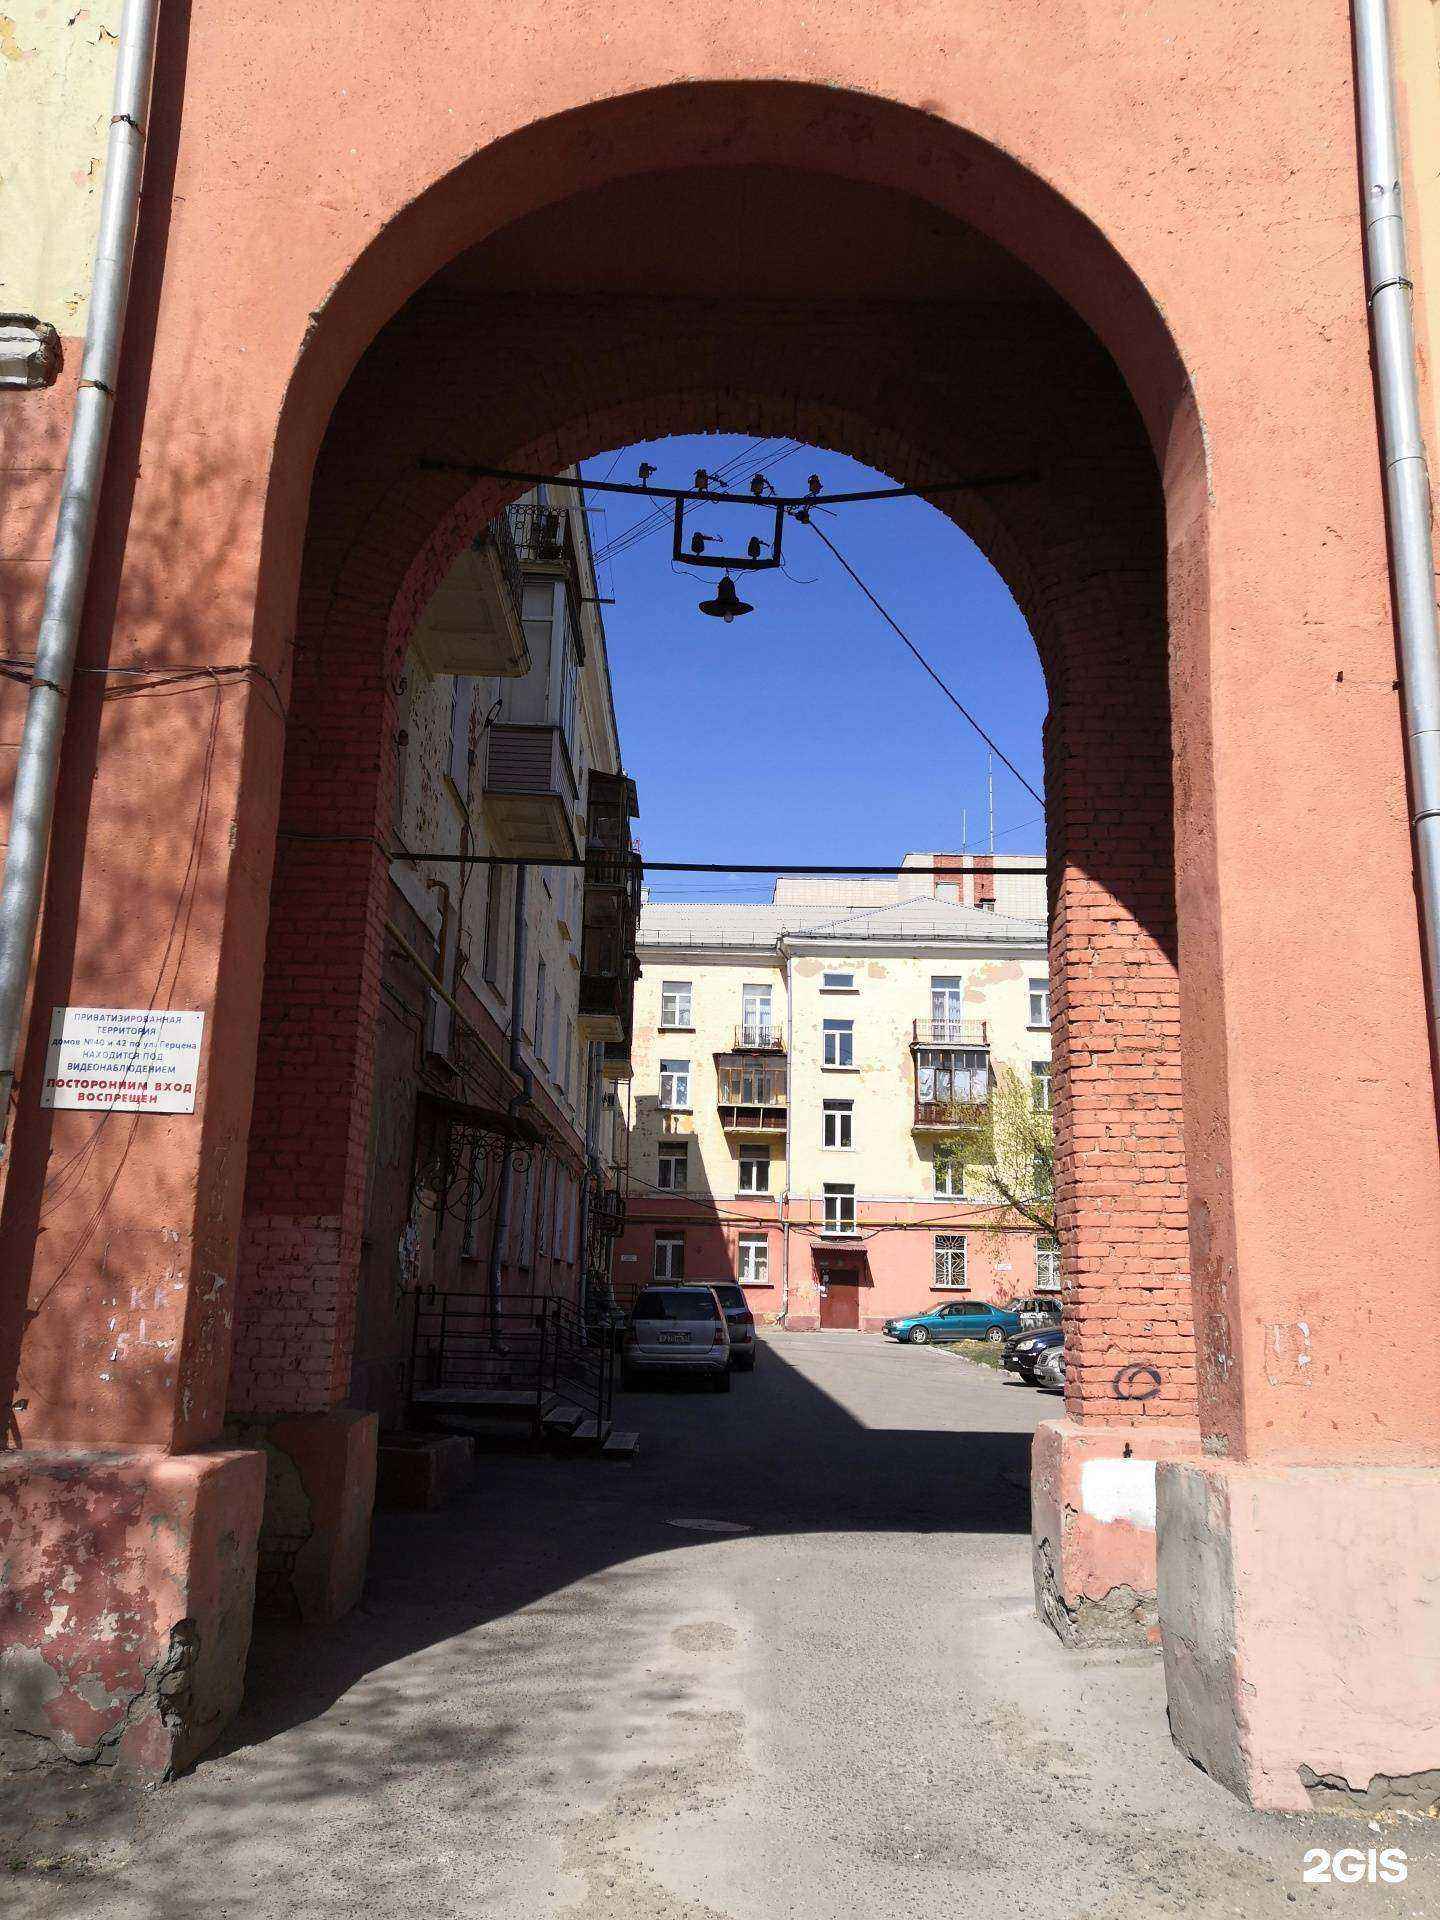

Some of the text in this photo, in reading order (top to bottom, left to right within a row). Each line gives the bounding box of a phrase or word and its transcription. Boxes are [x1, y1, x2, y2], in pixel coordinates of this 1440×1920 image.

[74, 1013, 182, 1024] ПРИВАТИЗИРОВАННАЯ
[97, 1026, 156, 1036] ТЕРРИТОРИЯ
[52, 1038, 80, 1046] домов
[159, 1041, 197, 1050] Герцена
[83, 1050, 163, 1061] НАХОДИТСЯ ПОД
[67, 1062, 176, 1074] ВИДЕОНАБЛЮДЕНИЕМ
[46, 1078, 192, 1094] ПОСТОРОННИМ ВХОД
[77, 1092, 159, 1104] ВОСПРЕЩЕН
